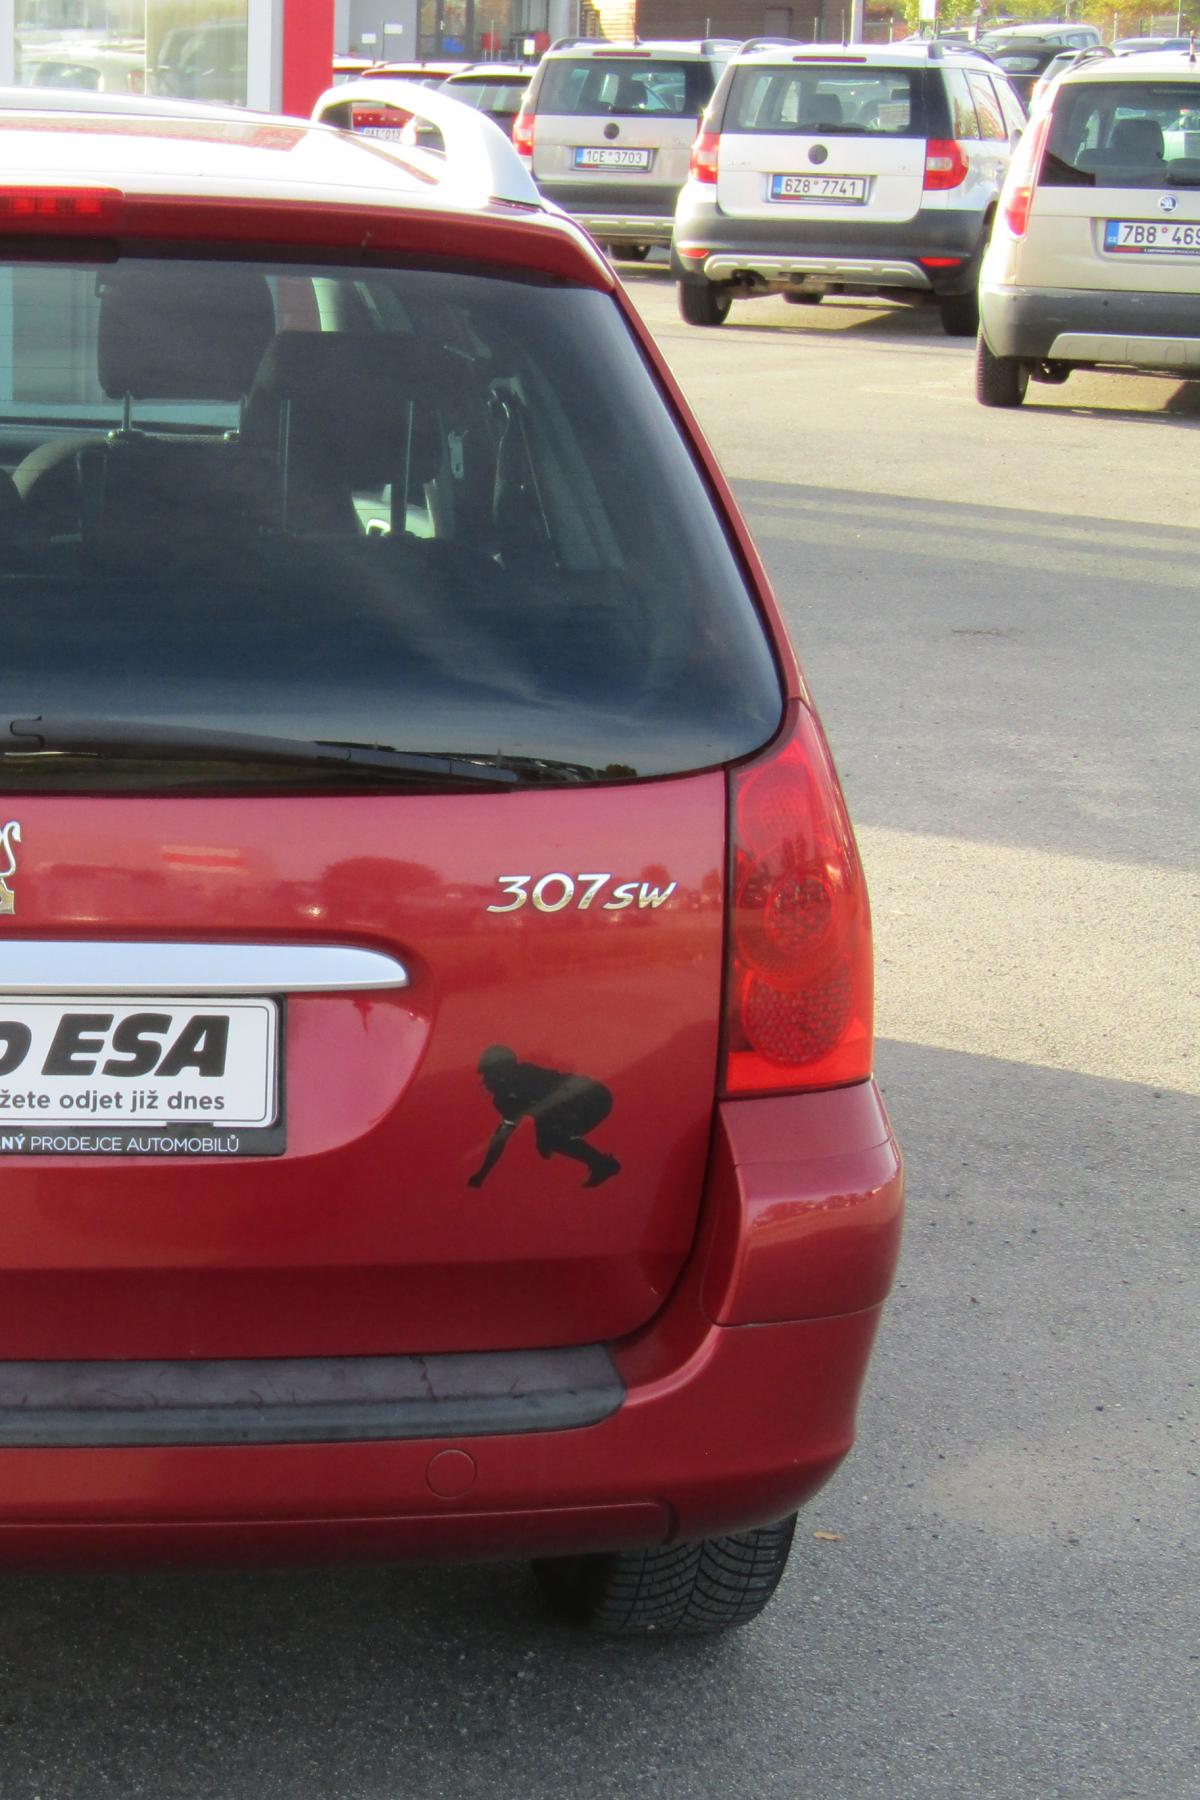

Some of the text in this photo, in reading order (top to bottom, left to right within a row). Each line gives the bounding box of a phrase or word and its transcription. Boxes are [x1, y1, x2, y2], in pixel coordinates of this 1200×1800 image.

[586, 150, 642, 164] 1CE 3703
[784, 178, 856, 196] 6Z8 7741
[1122, 225, 1157, 244] 7B8
[486, 872, 611, 913] 307
[40, 1012, 231, 1078] ESA
[59, 1089, 123, 1113] odjet
[129, 1089, 160, 1113] již
[167, 1091, 226, 1110] dnes
[30, 1135, 122, 1151] PRODEJCE
[126, 1133, 239, 1152] AUTOMOBILŮ
